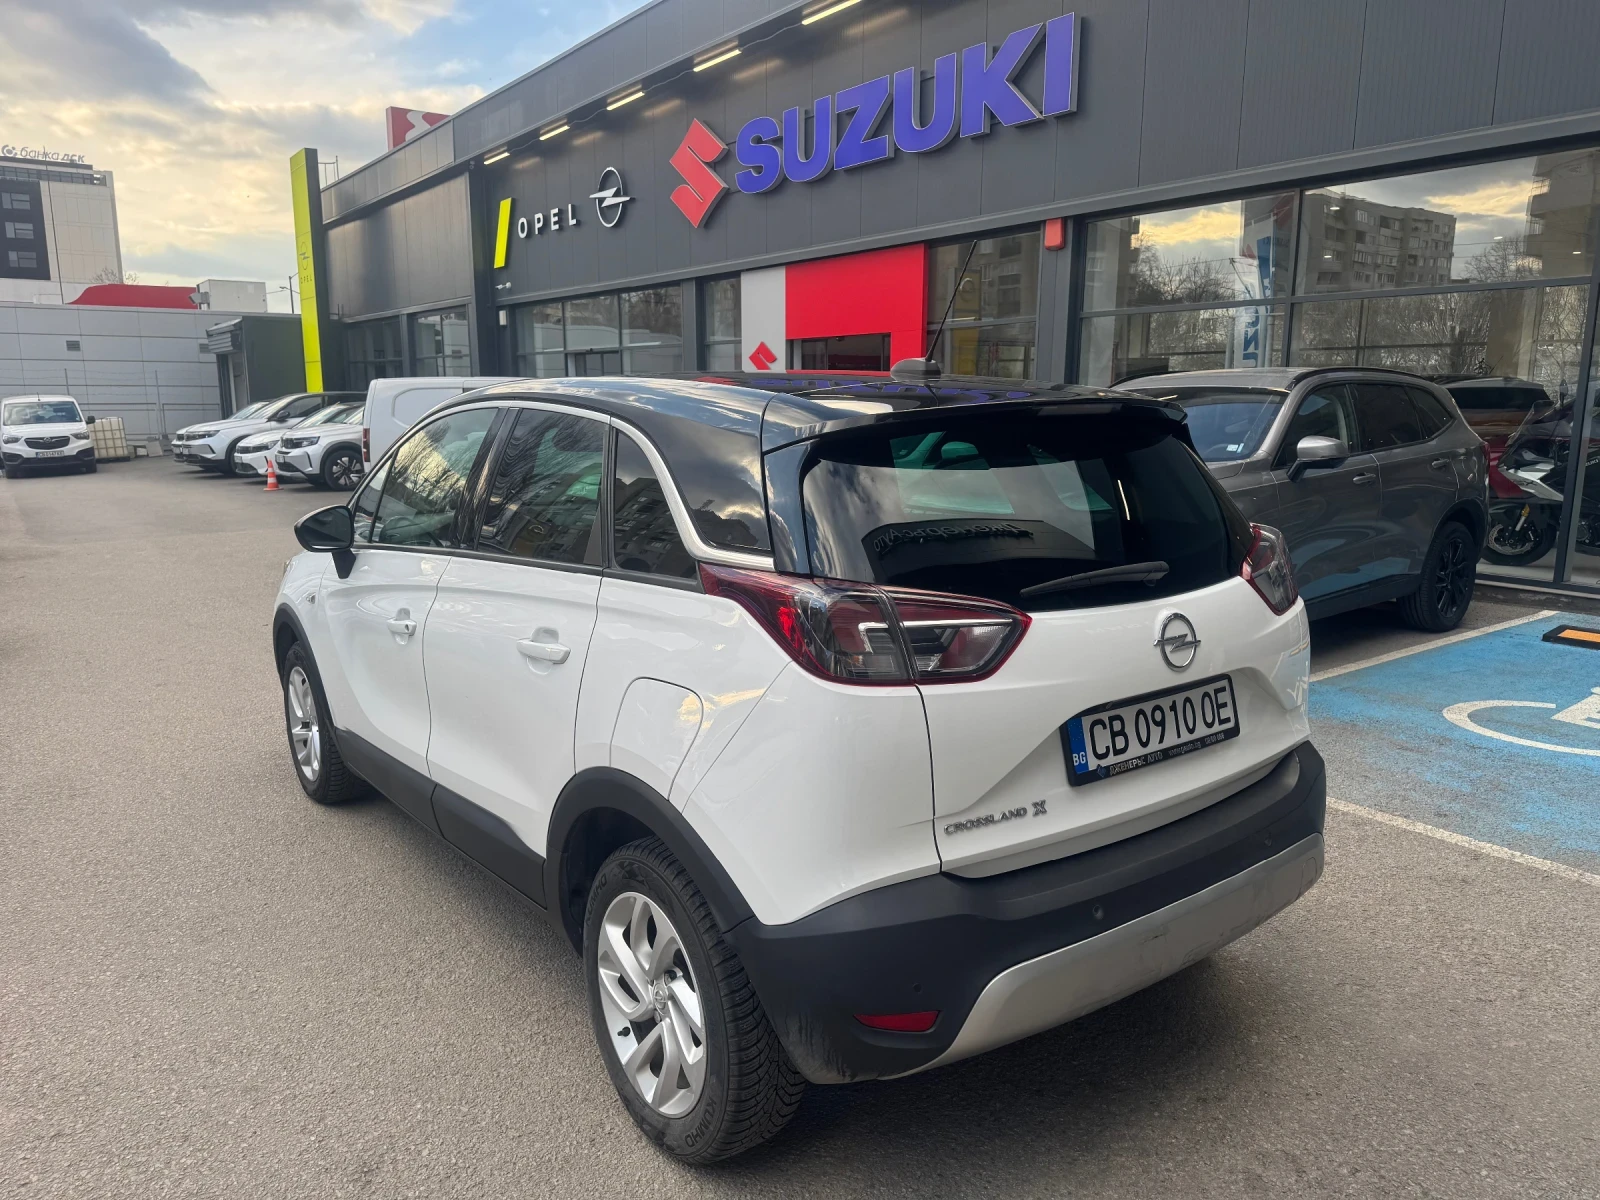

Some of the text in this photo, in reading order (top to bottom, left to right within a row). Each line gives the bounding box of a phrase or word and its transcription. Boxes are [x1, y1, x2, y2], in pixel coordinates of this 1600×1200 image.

[735, 12, 1079, 194] SUZUKI
[20, 146, 59, 160] банка
[517, 203, 577, 239] OPEL
[1089, 686, 1232, 760] CB 0910 OE
[1072, 752, 1087, 766] BG
[943, 799, 1048, 836] CROSSLAND X
[585, 872, 608, 927] KUMHO
[684, 1095, 717, 1148] KUMHO
